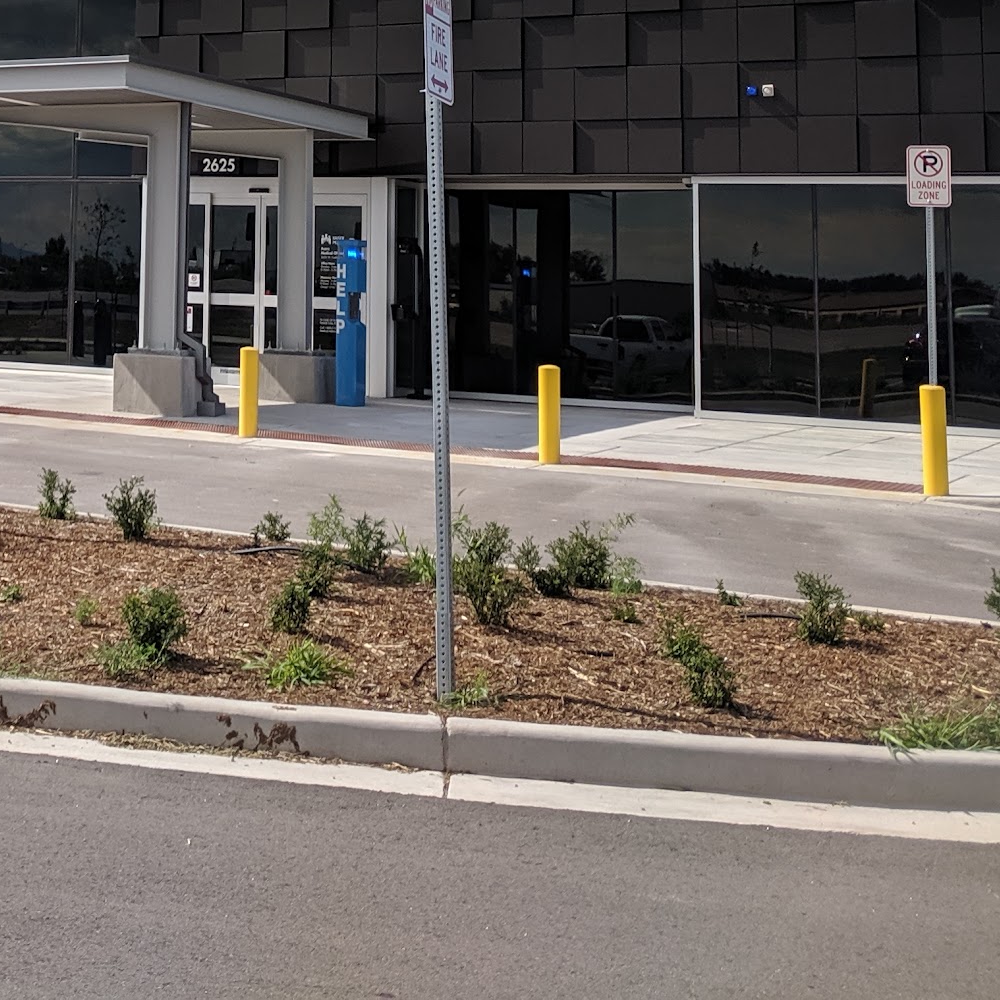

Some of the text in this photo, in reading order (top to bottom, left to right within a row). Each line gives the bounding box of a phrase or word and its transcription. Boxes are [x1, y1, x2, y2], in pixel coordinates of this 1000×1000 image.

[431, 23, 446, 47] FIRE
[430, 47, 448, 73] LANE
[203, 158, 235, 172] 2625
[912, 181, 947, 190] LOADING
[918, 191, 940, 200] ZONE
[336, 263, 347, 335] HELP
